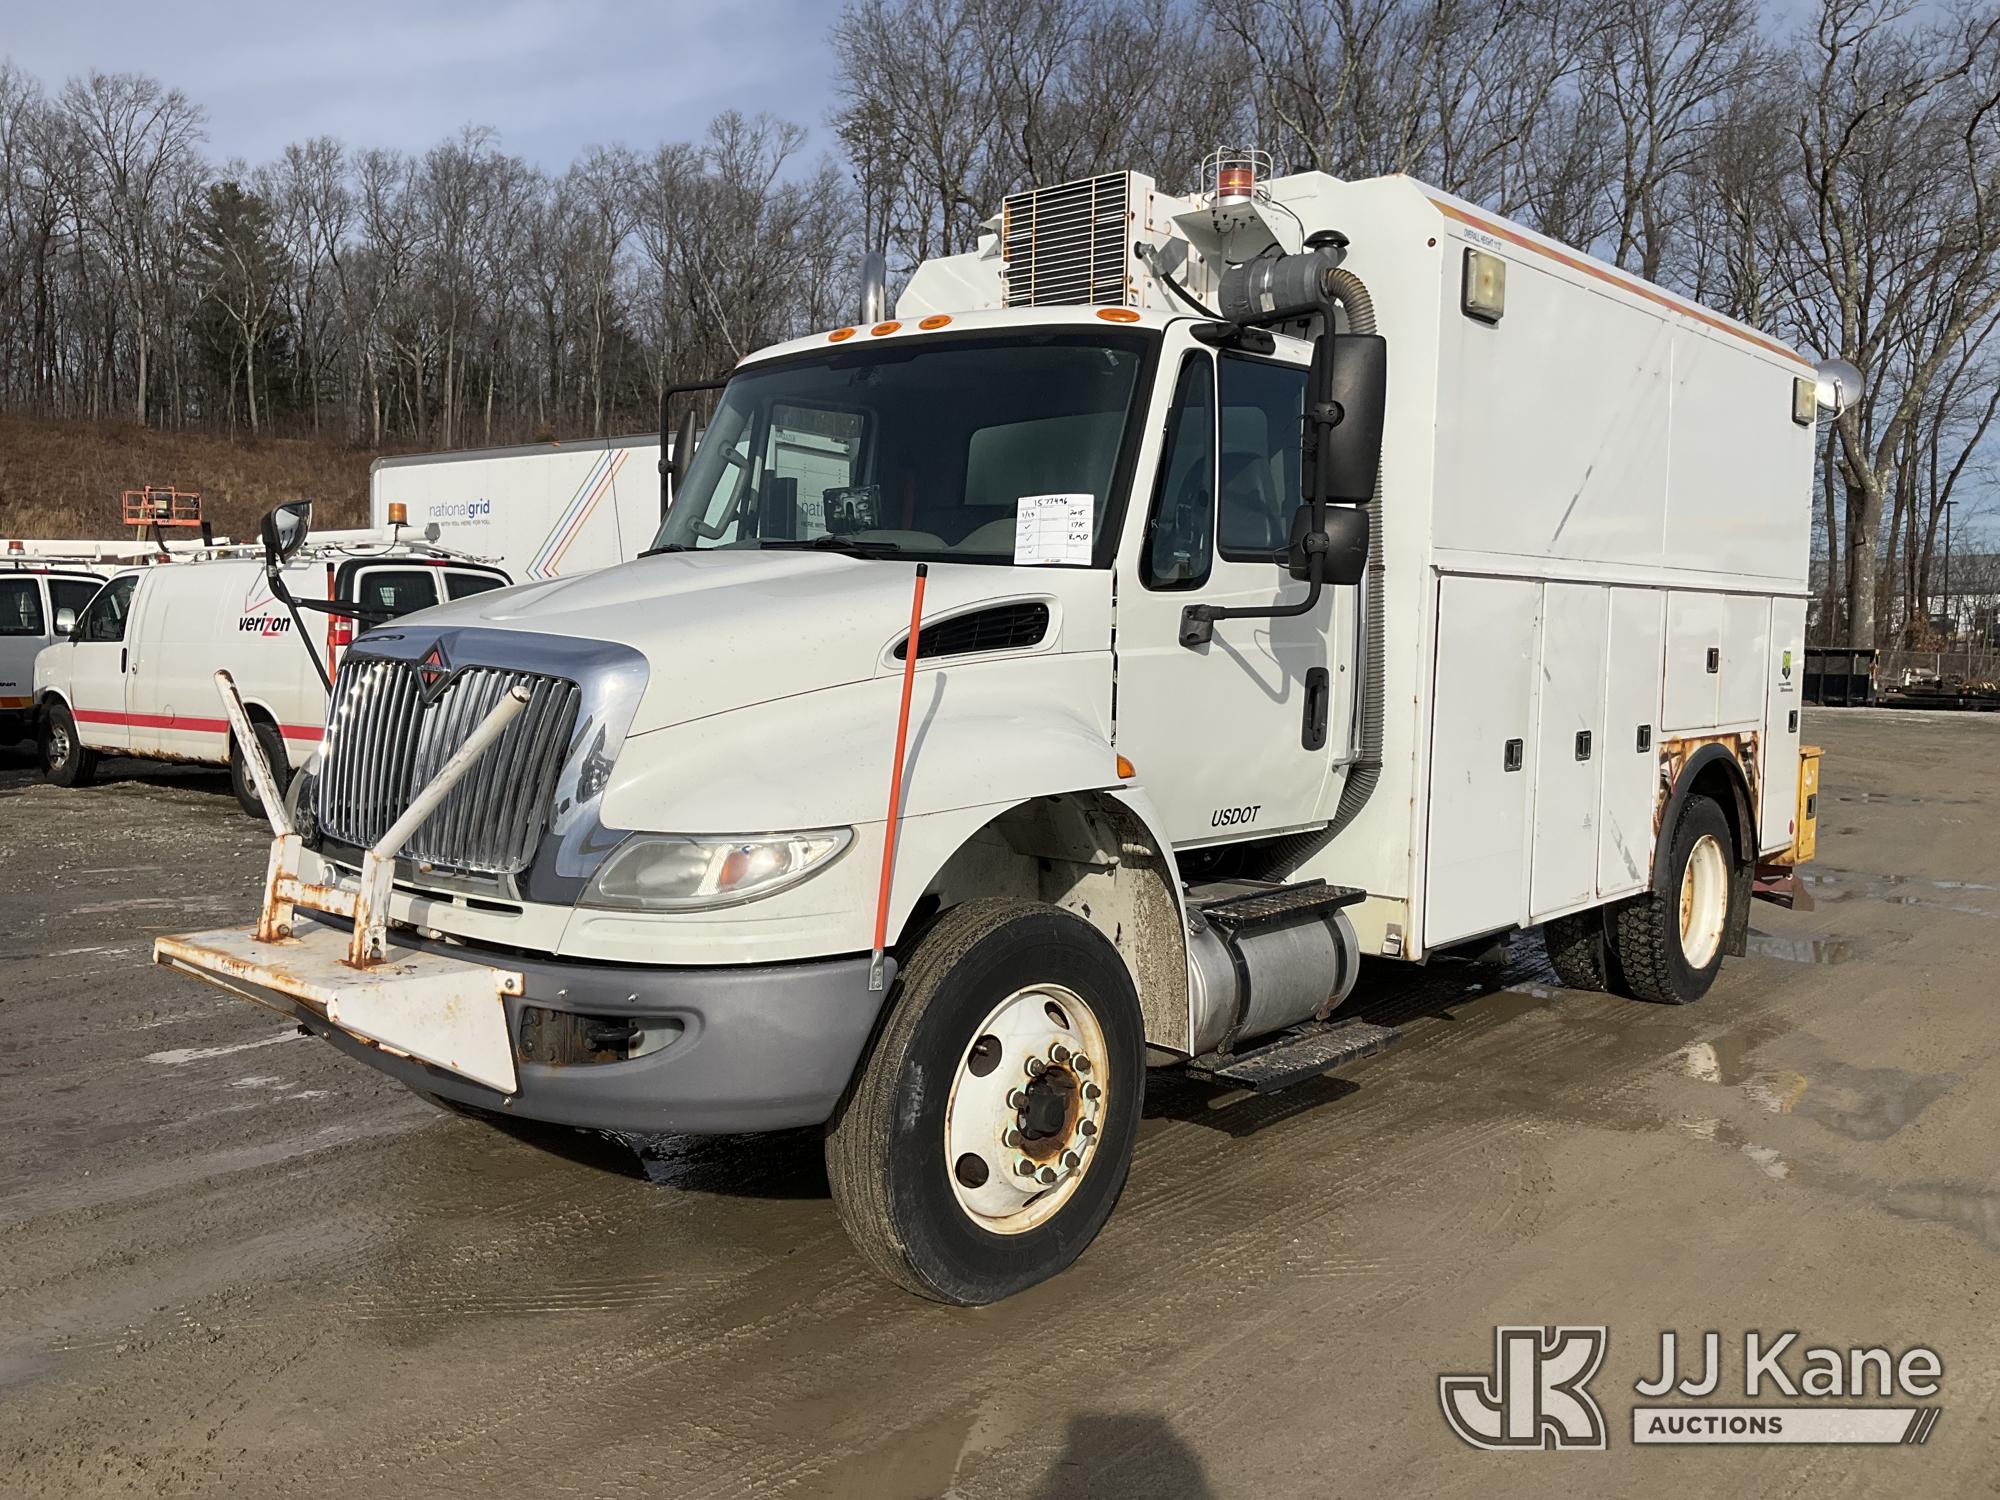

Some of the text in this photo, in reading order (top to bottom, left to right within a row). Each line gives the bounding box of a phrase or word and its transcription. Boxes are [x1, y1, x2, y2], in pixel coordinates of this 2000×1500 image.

[429, 498, 490, 519] nationalgrid
[239, 612, 291, 636] verizon
[1211, 805, 1262, 827] USDOT
